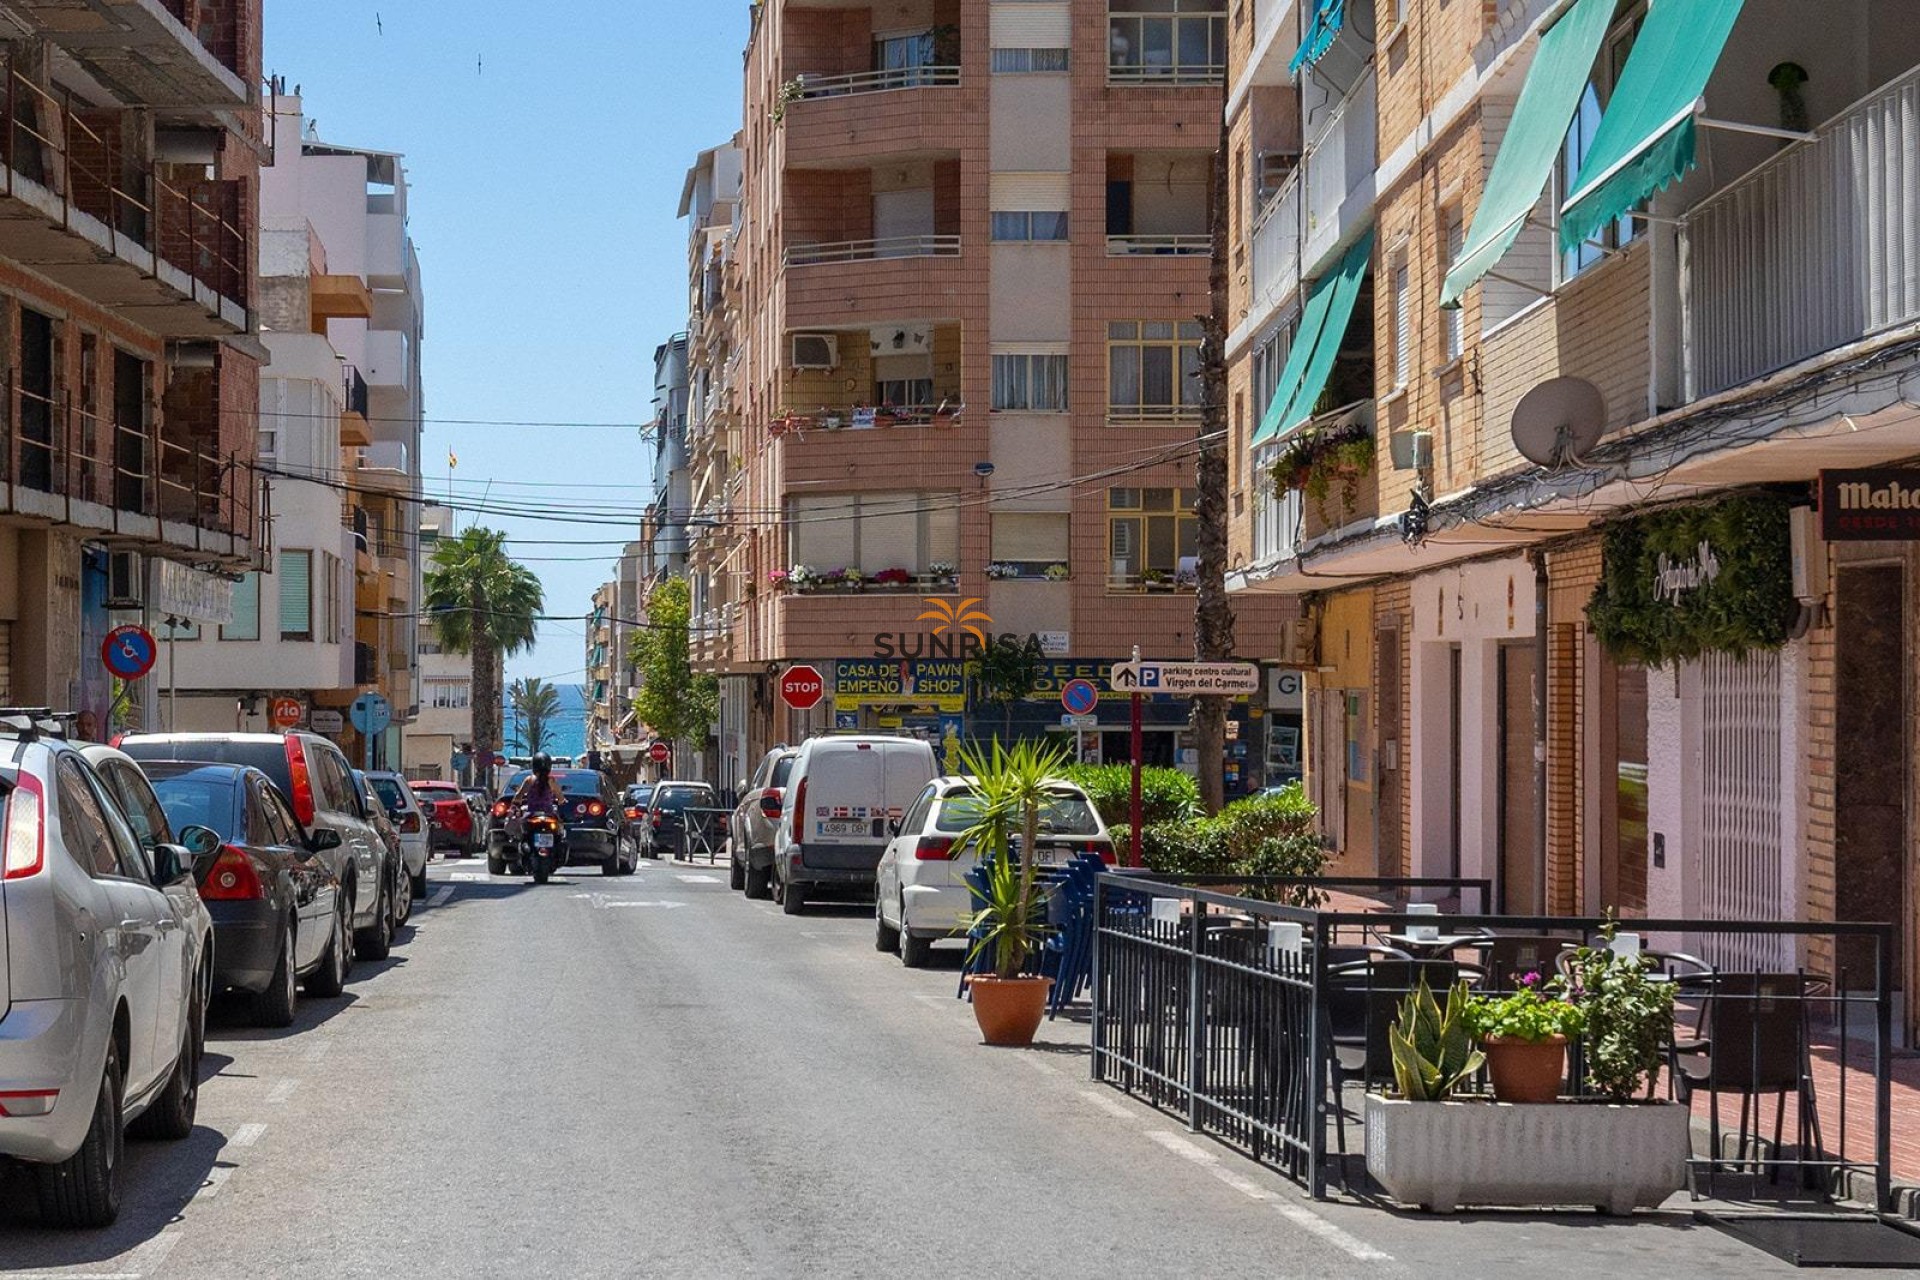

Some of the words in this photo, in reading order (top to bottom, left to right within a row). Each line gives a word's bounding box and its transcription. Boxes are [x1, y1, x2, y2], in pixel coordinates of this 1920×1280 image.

[837, 664, 877, 678] CASA
[879, 663, 899, 678] DE
[916, 663, 962, 677] PAWN
[1162, 666, 1193, 678] parking
[1194, 666, 1219, 676] centro
[1221, 667, 1252, 676] cultural
[785, 682, 819, 693] STOP
[918, 679, 960, 693] SHOP
[1165, 677, 1196, 689] Virgen
[1198, 678, 1213, 688] del
[1278, 675, 1303, 694] G
[276, 702, 299, 717] ria
